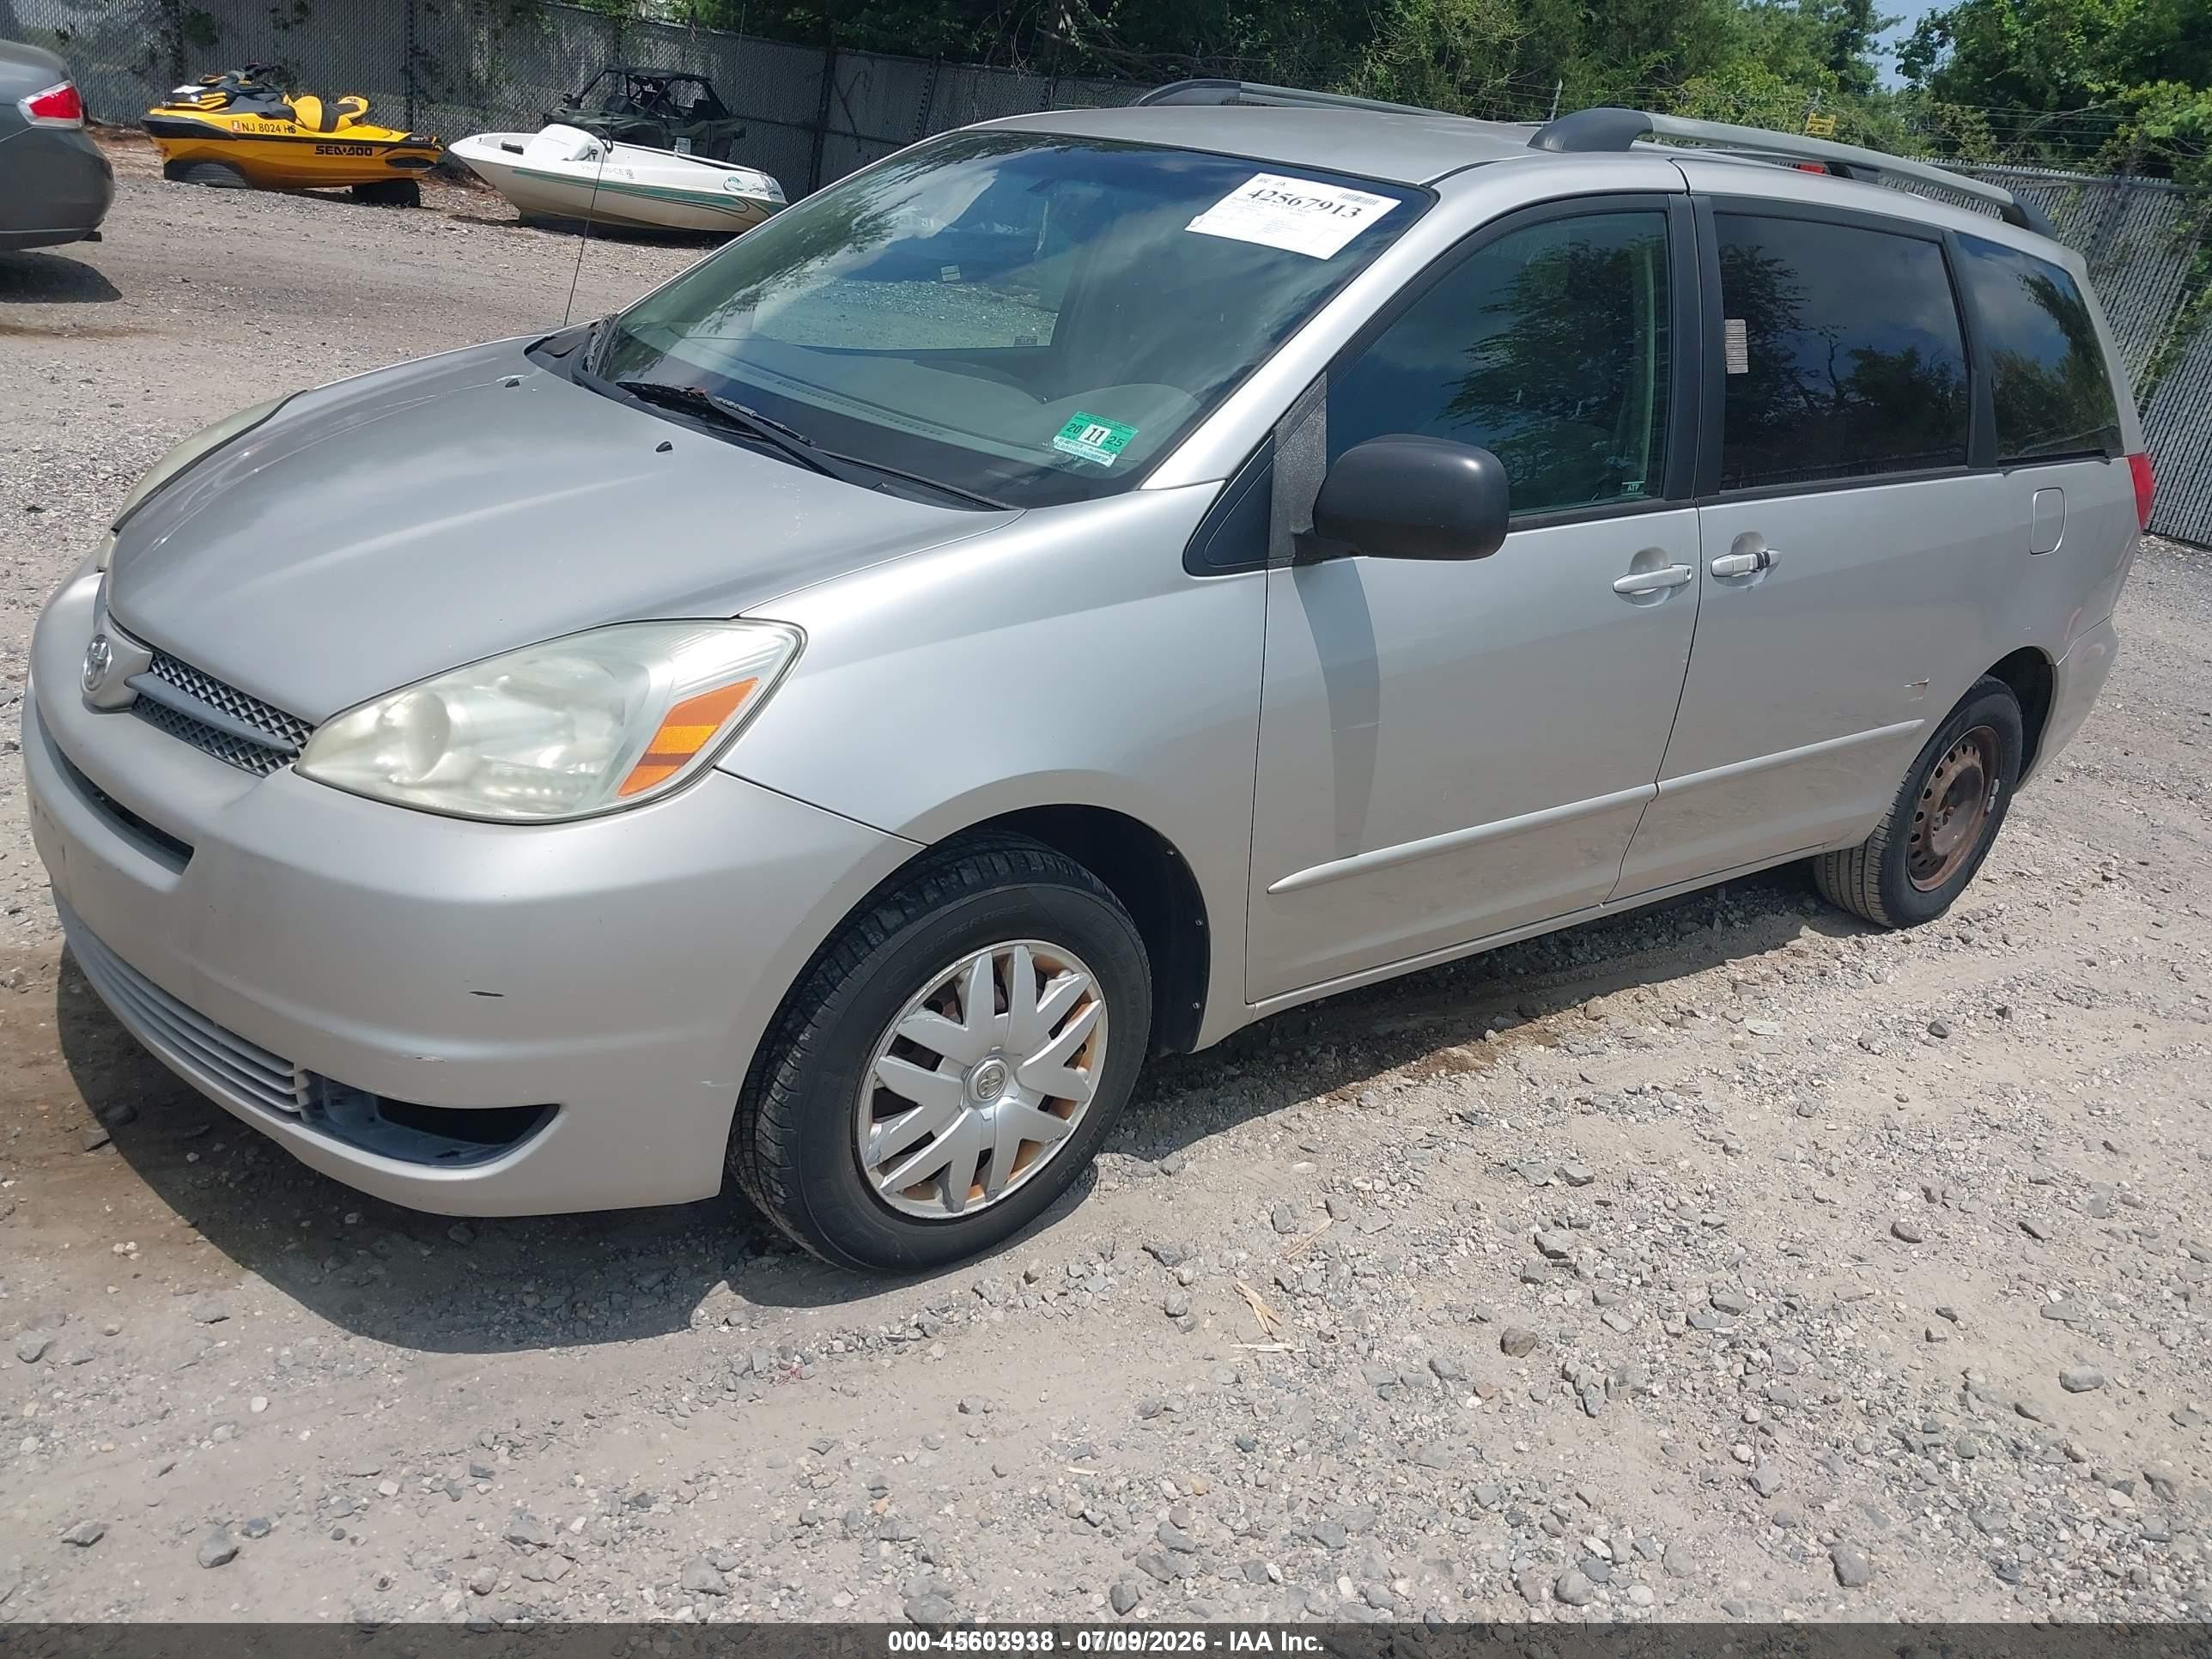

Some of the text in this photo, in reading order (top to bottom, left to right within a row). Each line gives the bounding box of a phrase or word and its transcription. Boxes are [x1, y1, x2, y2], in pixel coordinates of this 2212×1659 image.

[241, 123, 255, 132] NJ
[258, 123, 282, 133] 8024
[1247, 188, 1362, 218] 42567913
[1066, 422, 1126, 447] 20 11 25
